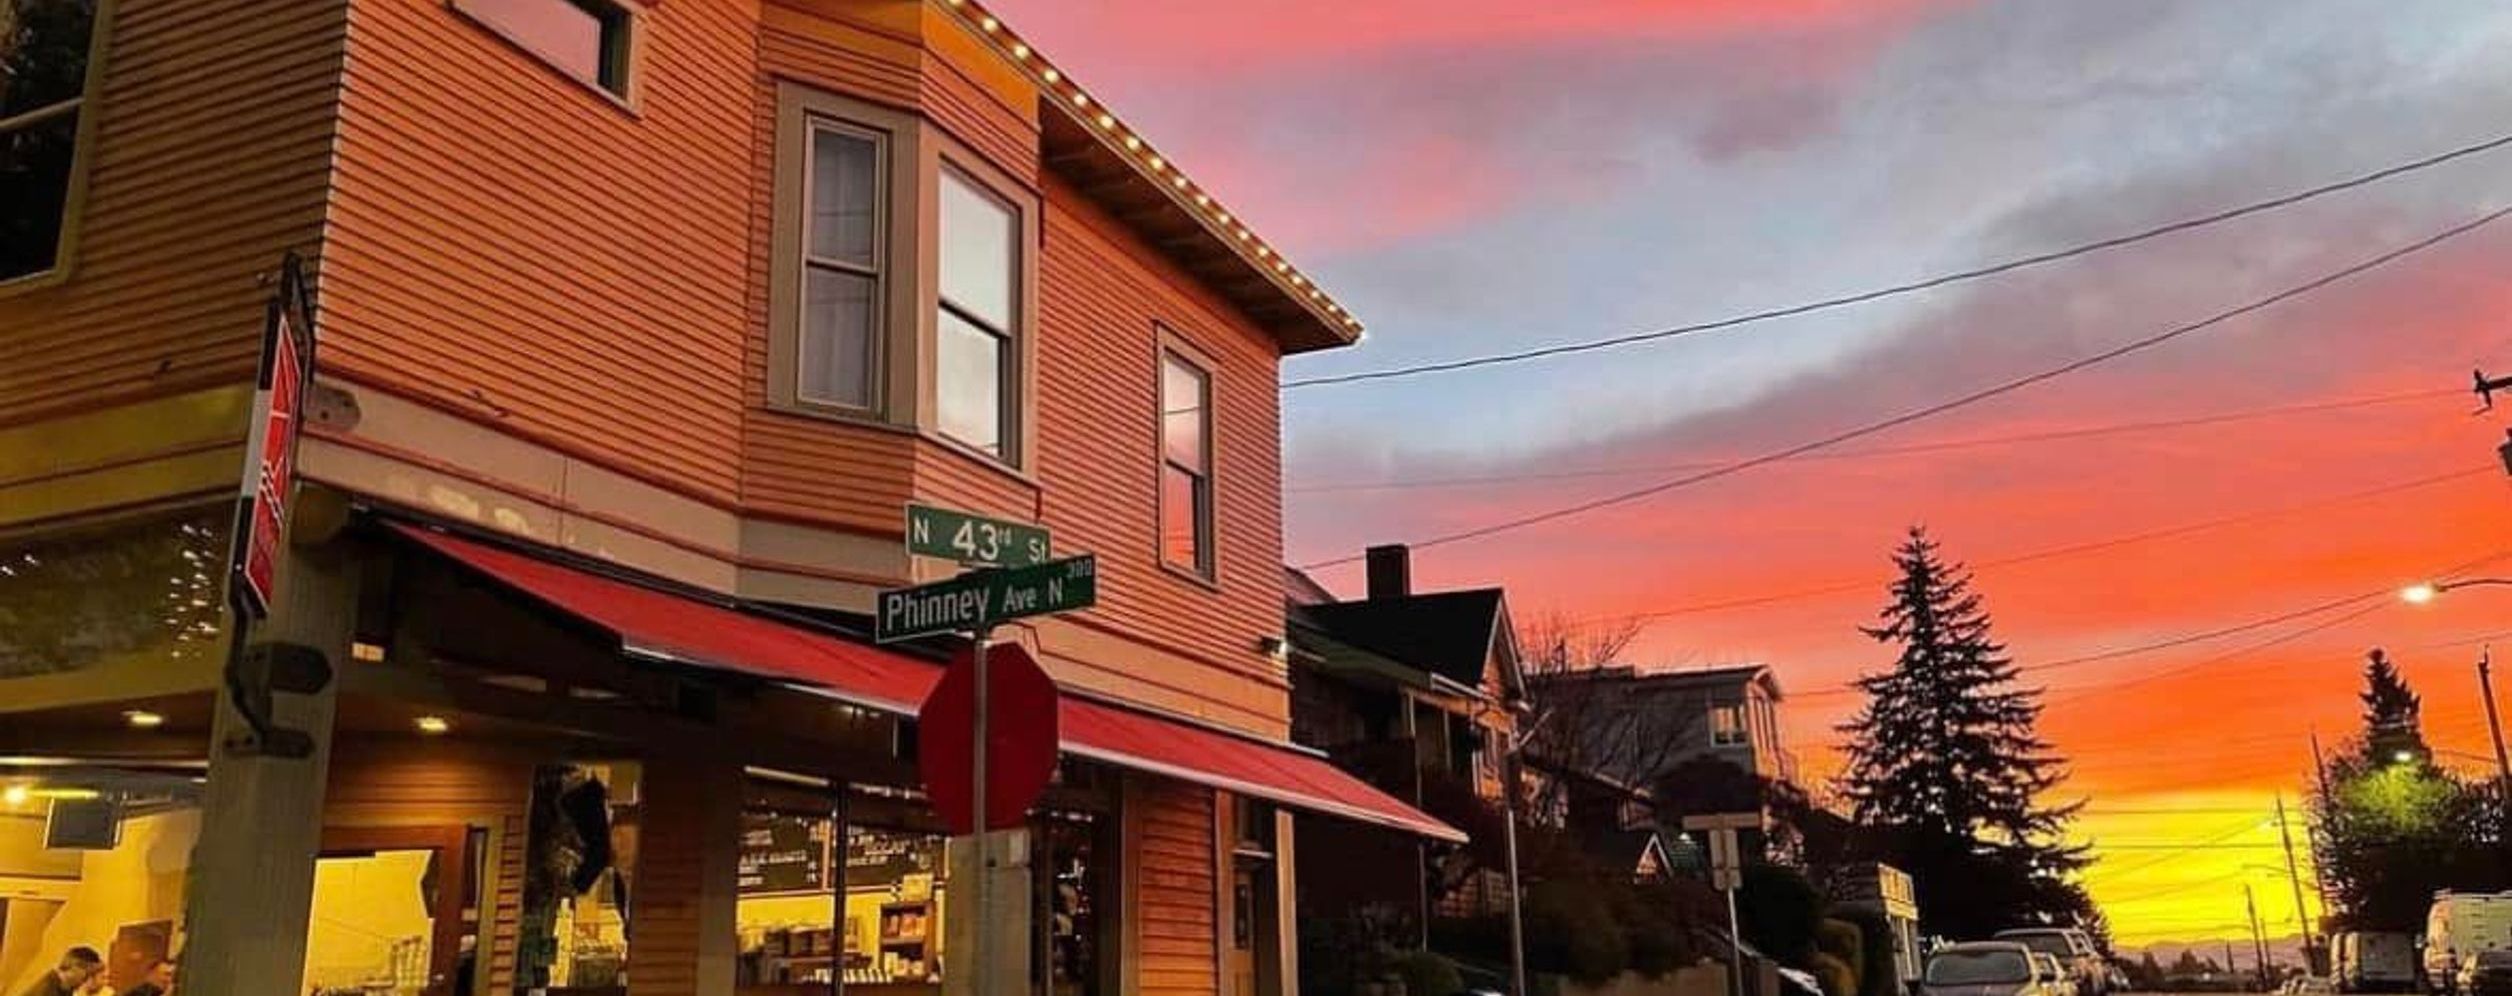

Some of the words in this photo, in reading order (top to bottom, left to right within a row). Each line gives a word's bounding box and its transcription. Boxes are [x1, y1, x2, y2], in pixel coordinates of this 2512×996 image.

[913, 517, 930, 544] N
[952, 520, 1012, 561] 43rd
[1028, 538, 1047, 564] St
[886, 587, 990, 631] Phinney
[1002, 584, 1037, 612] Ave
[1049, 576, 1063, 604] N
